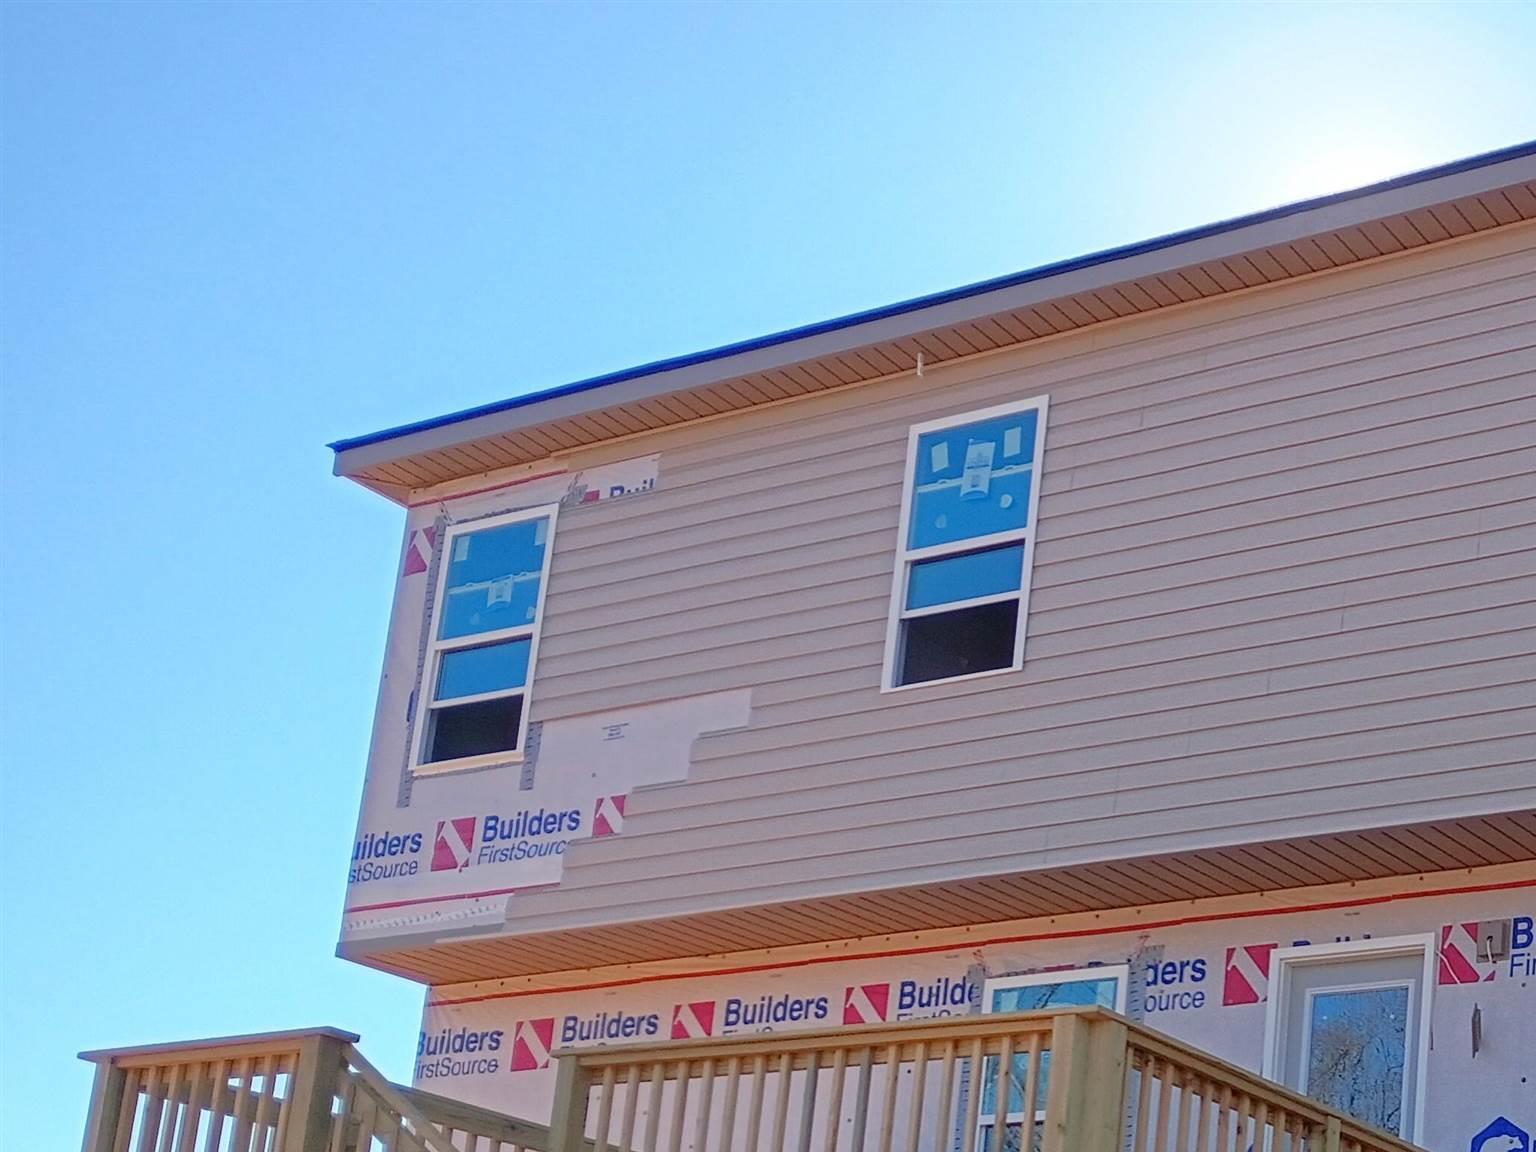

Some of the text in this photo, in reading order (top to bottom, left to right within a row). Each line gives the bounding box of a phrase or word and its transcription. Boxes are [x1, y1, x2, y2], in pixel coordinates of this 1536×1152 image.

[482, 809, 581, 843] Builders
[561, 1011, 660, 1043] Builders
[723, 994, 829, 1027] Builders
